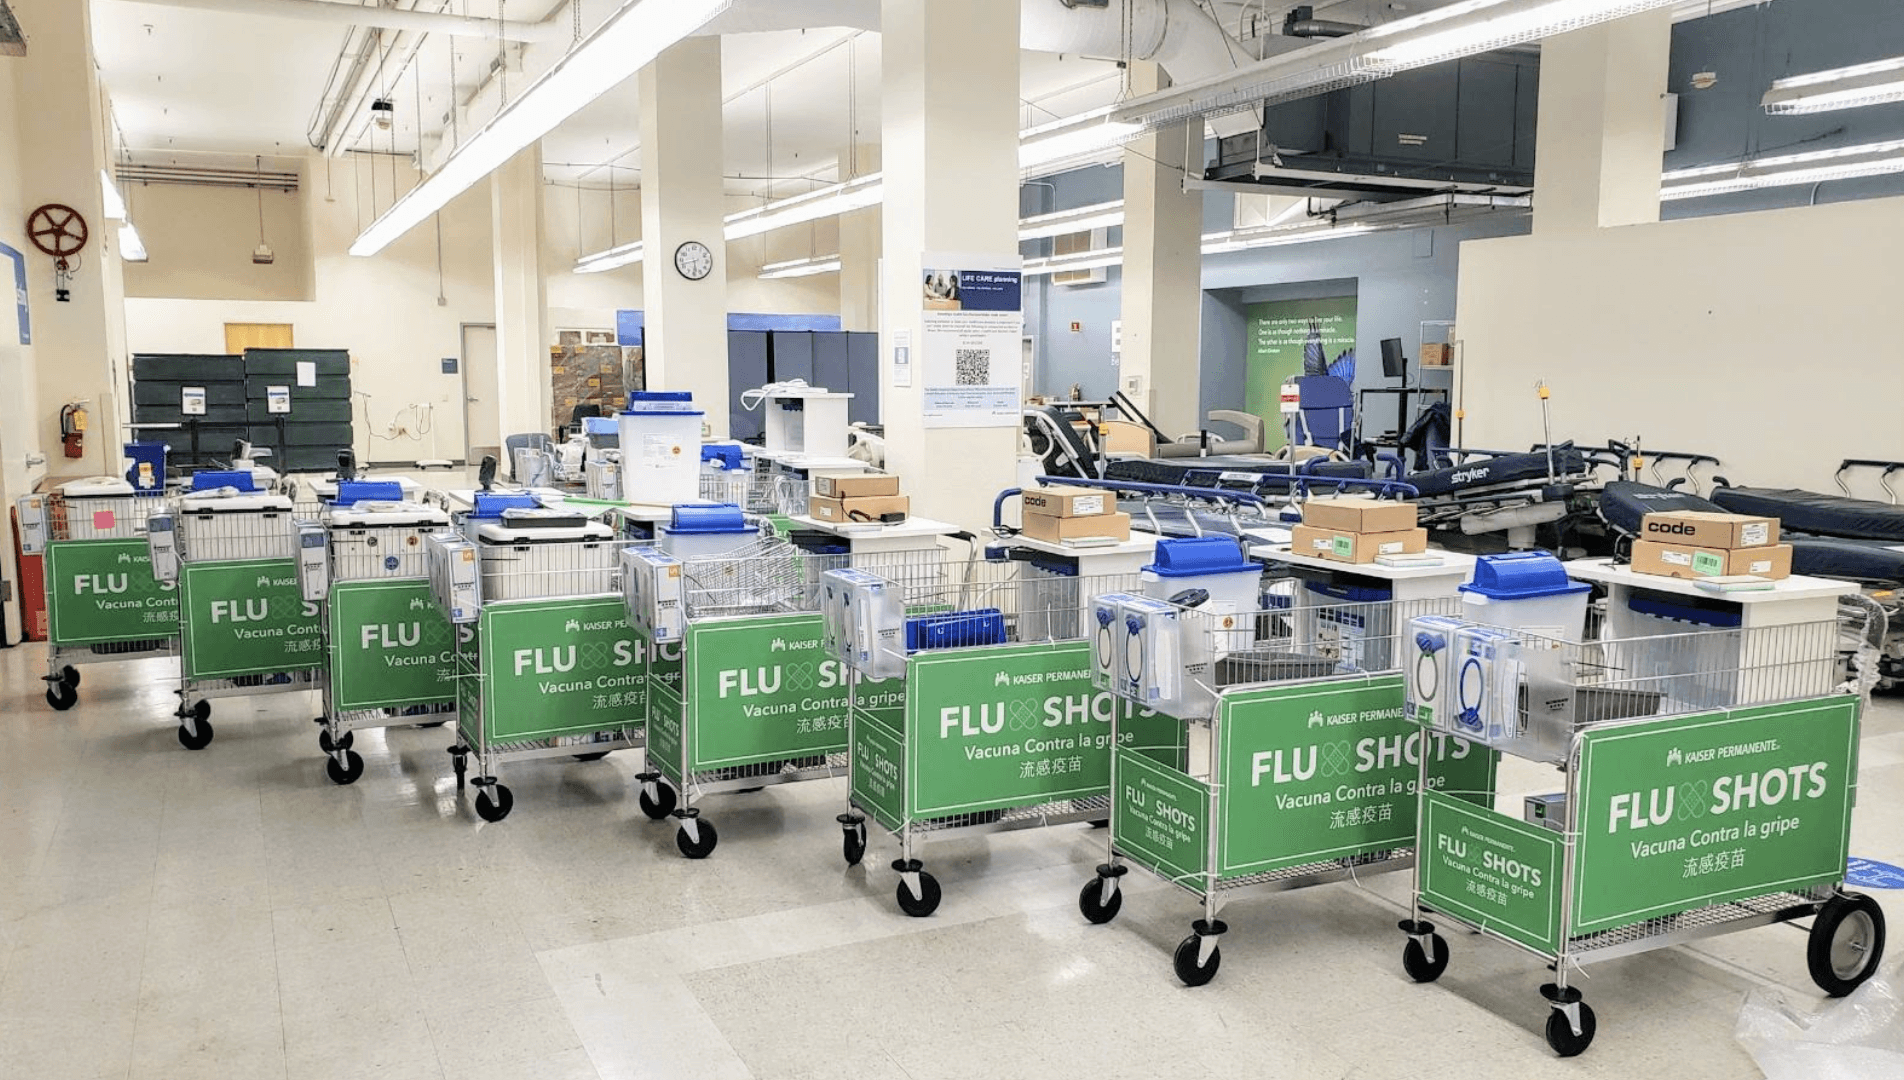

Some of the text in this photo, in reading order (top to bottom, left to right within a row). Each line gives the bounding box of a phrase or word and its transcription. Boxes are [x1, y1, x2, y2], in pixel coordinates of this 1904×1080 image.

[1451, 468, 1490, 484] stryker
[1024, 496, 1046, 508] code
[1648, 522, 1696, 536] code
[74, 573, 128, 594] FLU
[96, 600, 142, 610] Vacuna
[211, 598, 268, 624] FLU
[234, 628, 284, 640] Vacuna
[362, 622, 420, 649] FLU
[584, 621, 612, 630] KAISER
[789, 640, 818, 650] KAISER
[384, 655, 436, 667] Vacuna
[514, 645, 576, 676] FLU
[539, 682, 592, 694] Vacuna
[596, 674, 644, 688] Contra
[719, 666, 781, 698] FLU
[1013, 672, 1044, 686] KAISER
[743, 702, 797, 718] Vacuna
[801, 697, 848, 711] Contra
[870, 690, 905, 708] gripe
[1326, 707, 1403, 726] KAISER PERMANE
[940, 702, 1004, 738] FLU
[964, 732, 1134, 760] Vacuna Contra la grpe
[1684, 748, 1716, 764] KAISER
[875, 754, 898, 780] SHOTS
[1020, 756, 1082, 778] 流感疫苗
[1252, 745, 1318, 787] FLU
[1276, 776, 1446, 810] Vacuna Contra la gpe
[1608, 761, 1828, 834] FLU SHOTS
[1126, 784, 1145, 807] FLU
[1156, 800, 1195, 832] SHOTS
[1330, 804, 1393, 830] 流感疫苗
[1631, 815, 1800, 858] Vacuna Contra la gripe
[1438, 833, 1542, 886] FLU SHOTS
[1682, 847, 1746, 878] 流感疫苗
[1442, 854, 1534, 899] Vacuna Contra la gripe
